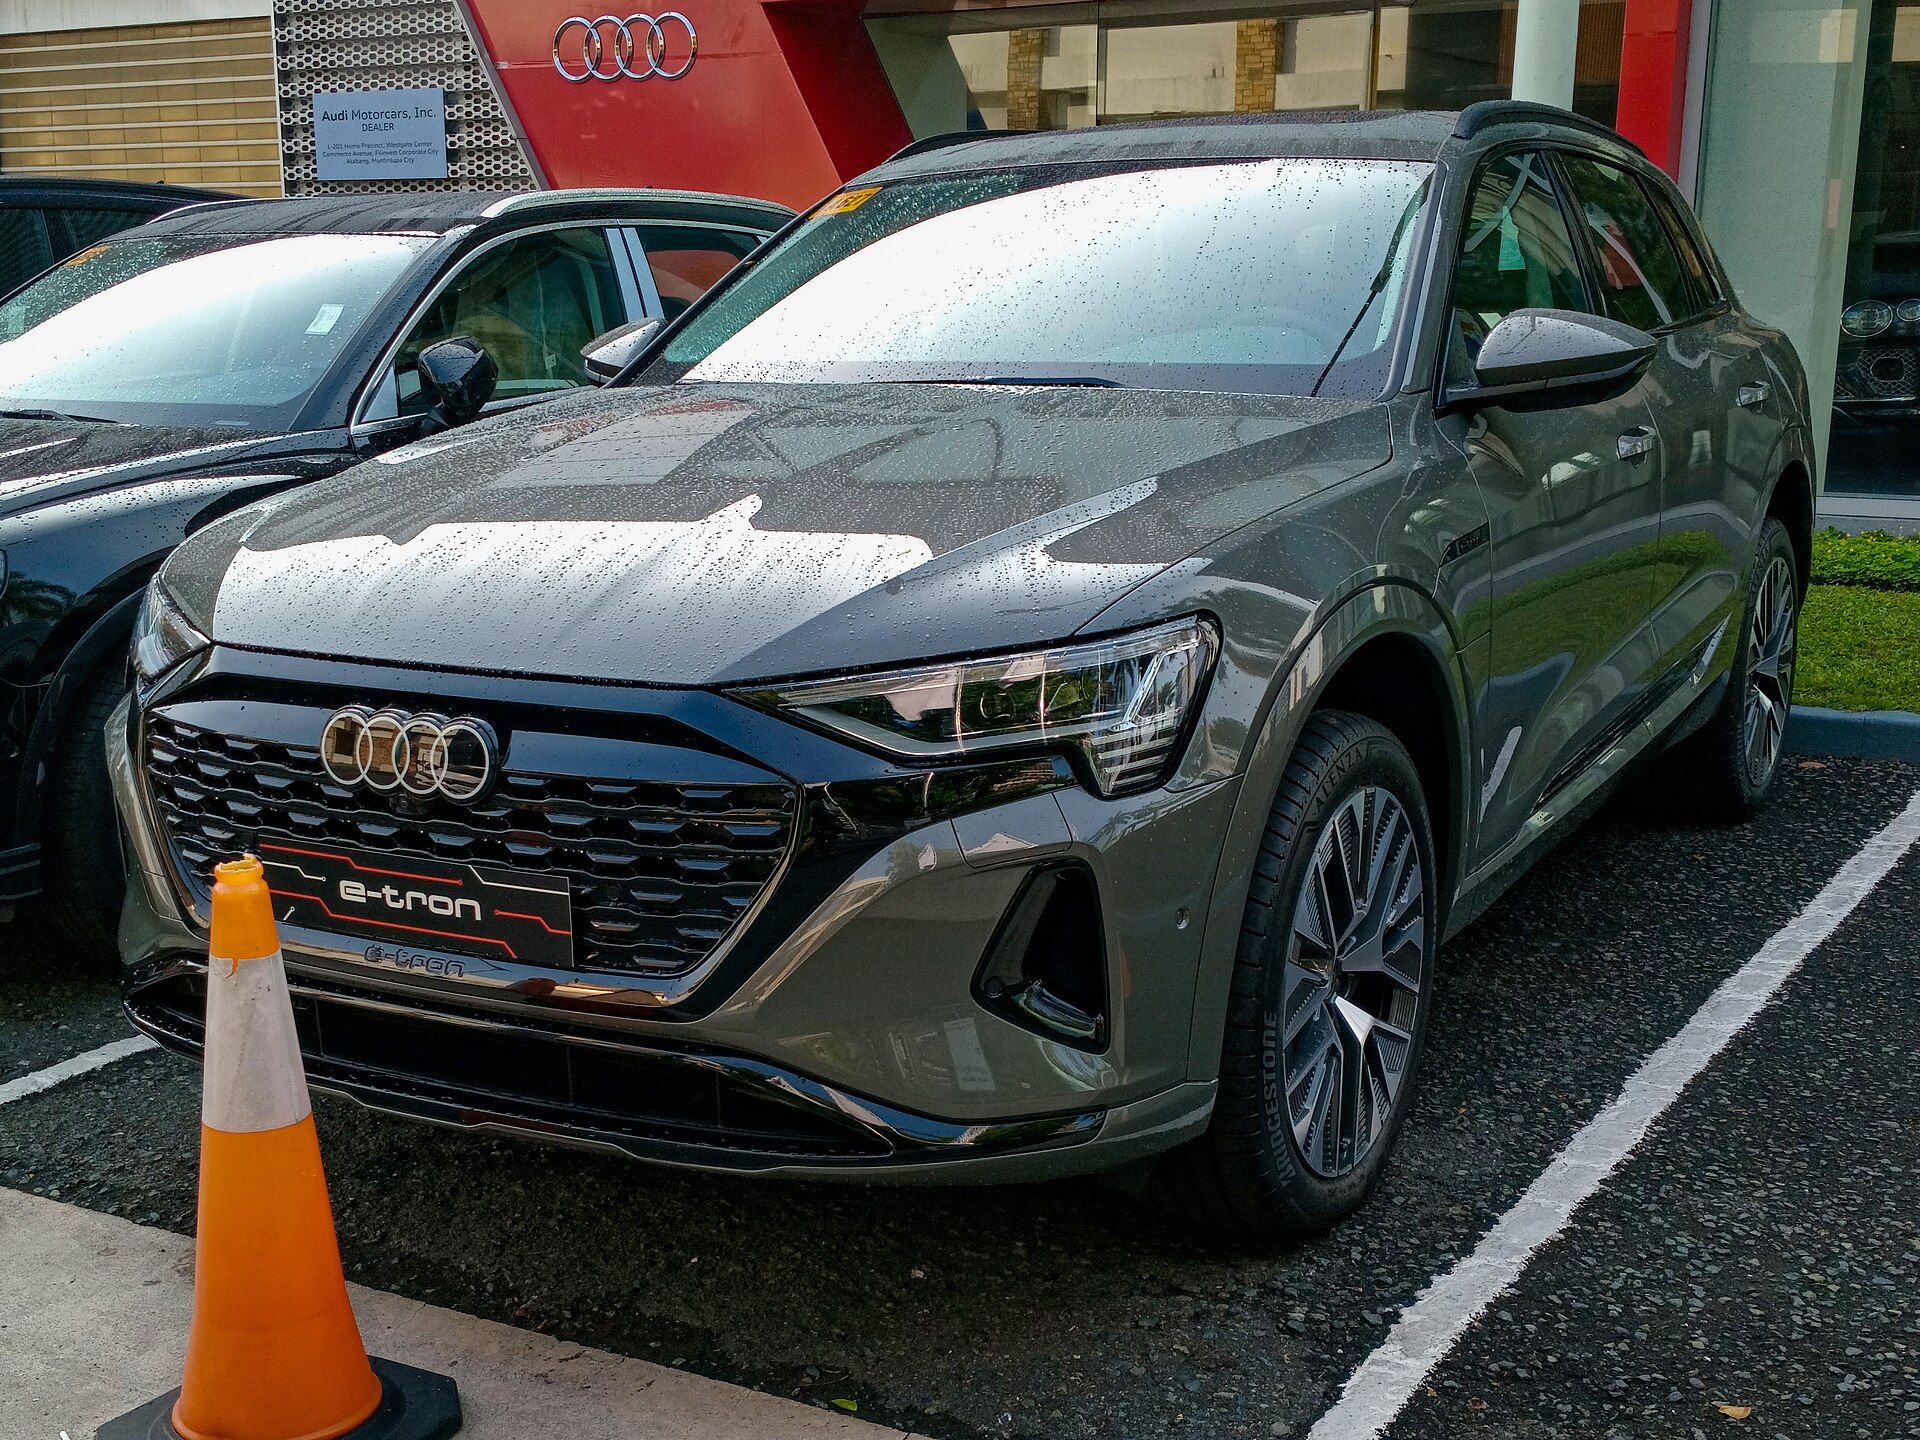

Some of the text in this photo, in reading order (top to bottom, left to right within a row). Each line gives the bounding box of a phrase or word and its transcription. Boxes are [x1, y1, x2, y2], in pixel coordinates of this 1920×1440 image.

[321, 107, 436, 121] Audi Motorcars, Inc.
[361, 122, 395, 132] DEALER
[386, 141, 412, 149] Westgate
[398, 149, 427, 157] Corporate
[427, 148, 439, 156] City
[403, 156, 415, 164] City
[1315, 747, 1363, 811] ALENZA
[339, 880, 482, 921] e-tron
[363, 944, 466, 978] e-tron
[1262, 1010, 1298, 1187] BRIDGESTONE
